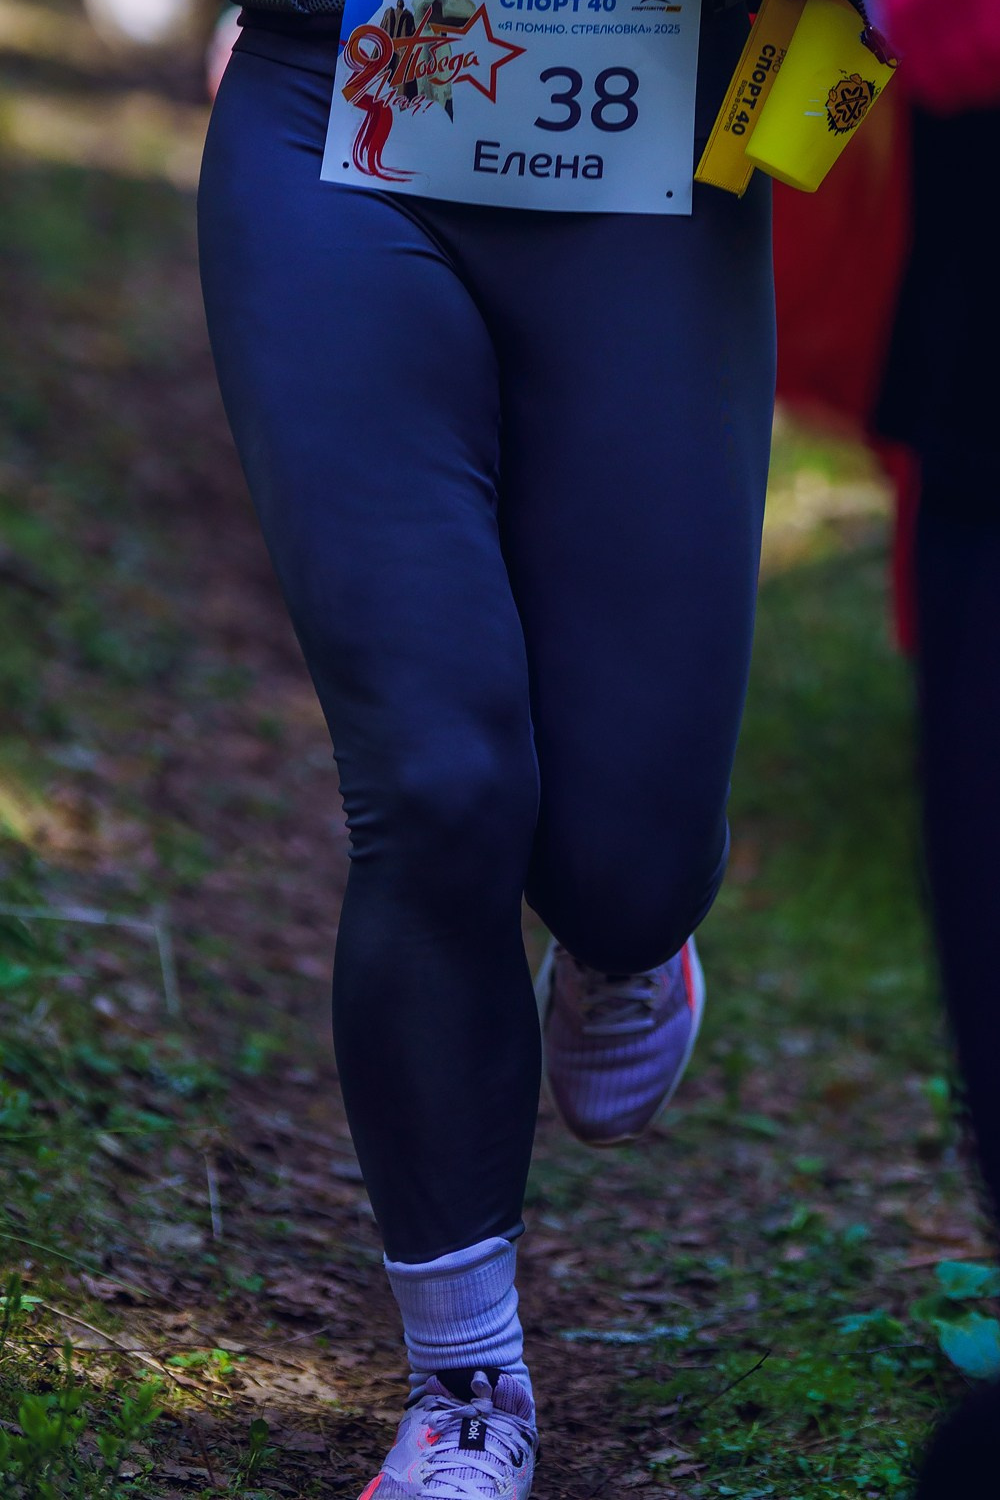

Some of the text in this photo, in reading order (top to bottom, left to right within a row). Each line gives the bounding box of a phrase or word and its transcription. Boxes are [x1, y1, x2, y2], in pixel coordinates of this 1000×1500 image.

[498, 21, 681, 35] «Я ПОМНЮ. СТРЕЛКОВКА» 2025
[772, 48, 788, 74] PRO
[534, 66, 640, 133] 38
[731, 43, 777, 136] СПОРТ 40
[473, 140, 604, 179] Елена
